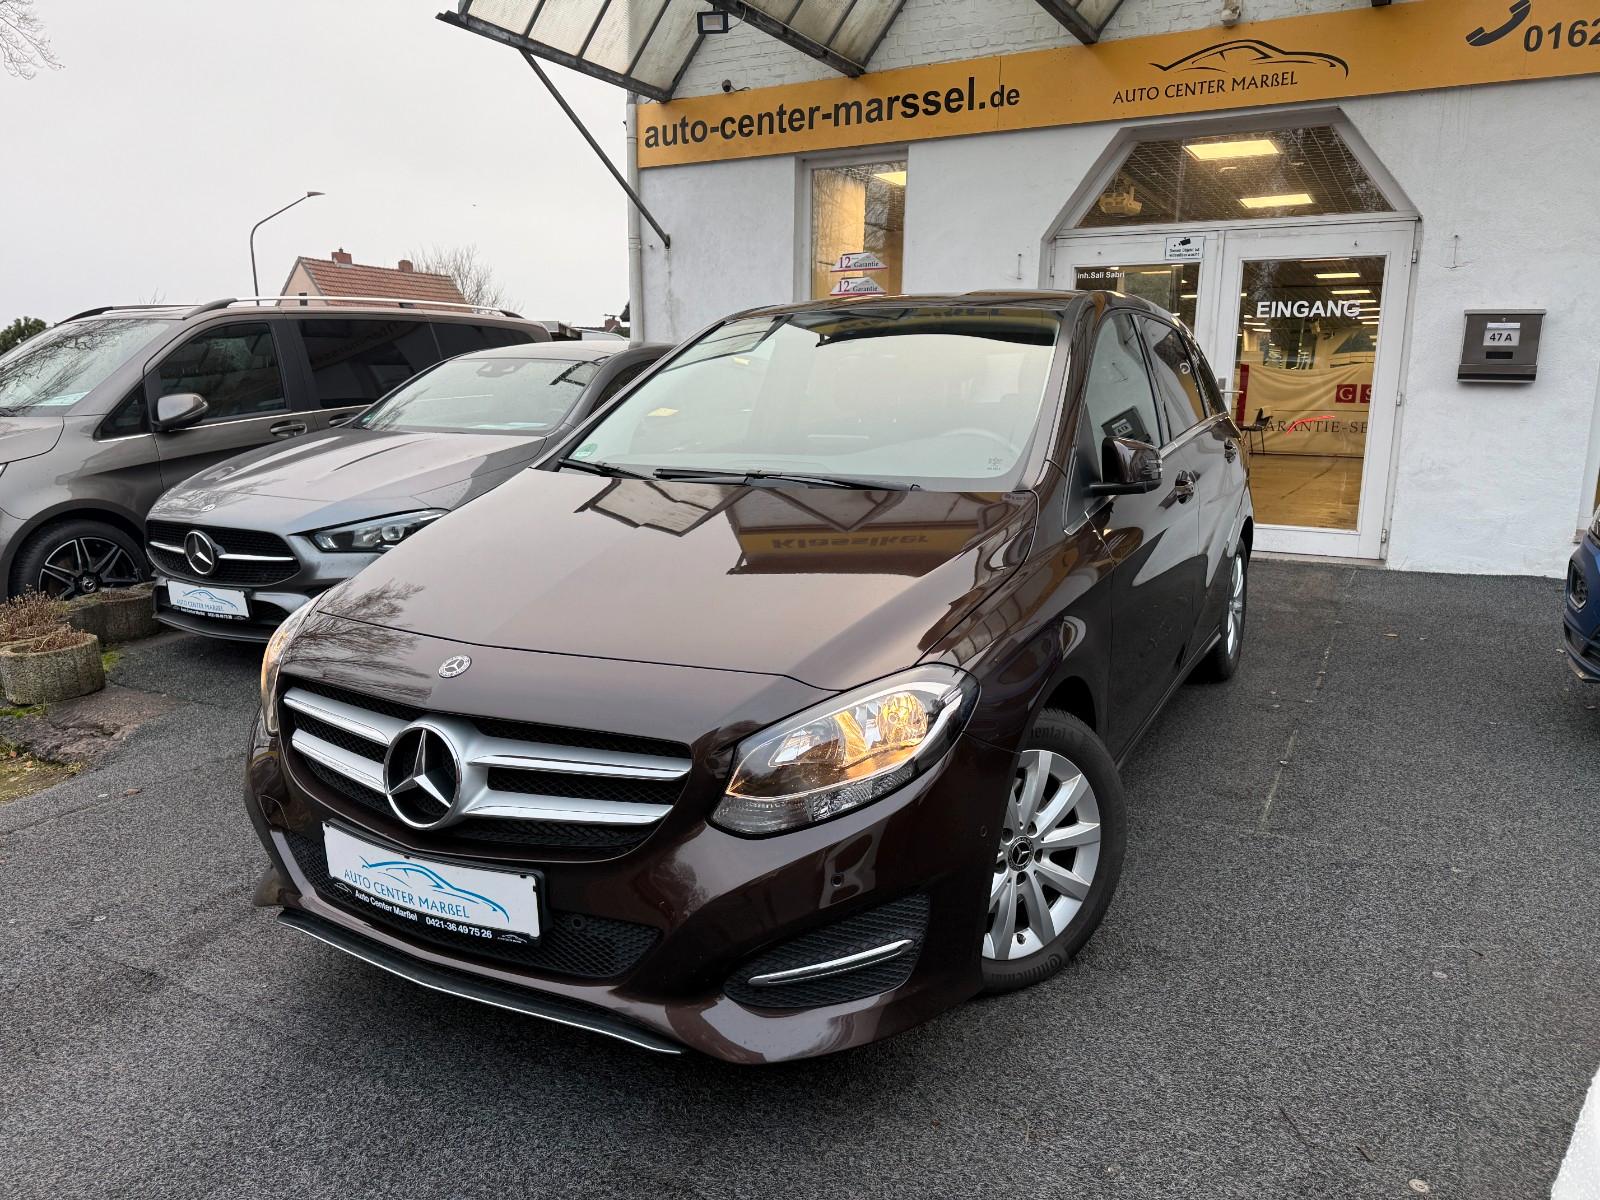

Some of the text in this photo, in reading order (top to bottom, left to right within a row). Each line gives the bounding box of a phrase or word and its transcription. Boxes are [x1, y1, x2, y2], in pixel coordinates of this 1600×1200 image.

[1524, 17, 1600, 52] 0162
[1113, 86, 1159, 104] AUTO
[1164, 79, 1225, 98] CENTER
[644, 76, 1020, 149] auto-center-marssel.de
[839, 256, 879, 269] 12 Garantie
[838, 280, 850, 293] 12
[1256, 300, 1361, 318] EINGANG
[1489, 333, 1513, 342] 47 A
[344, 869, 371, 889] AUTO
[373, 881, 415, 905] CENTER
[355, 889, 370, 903] Auto
[370, 896, 392, 913] Center
